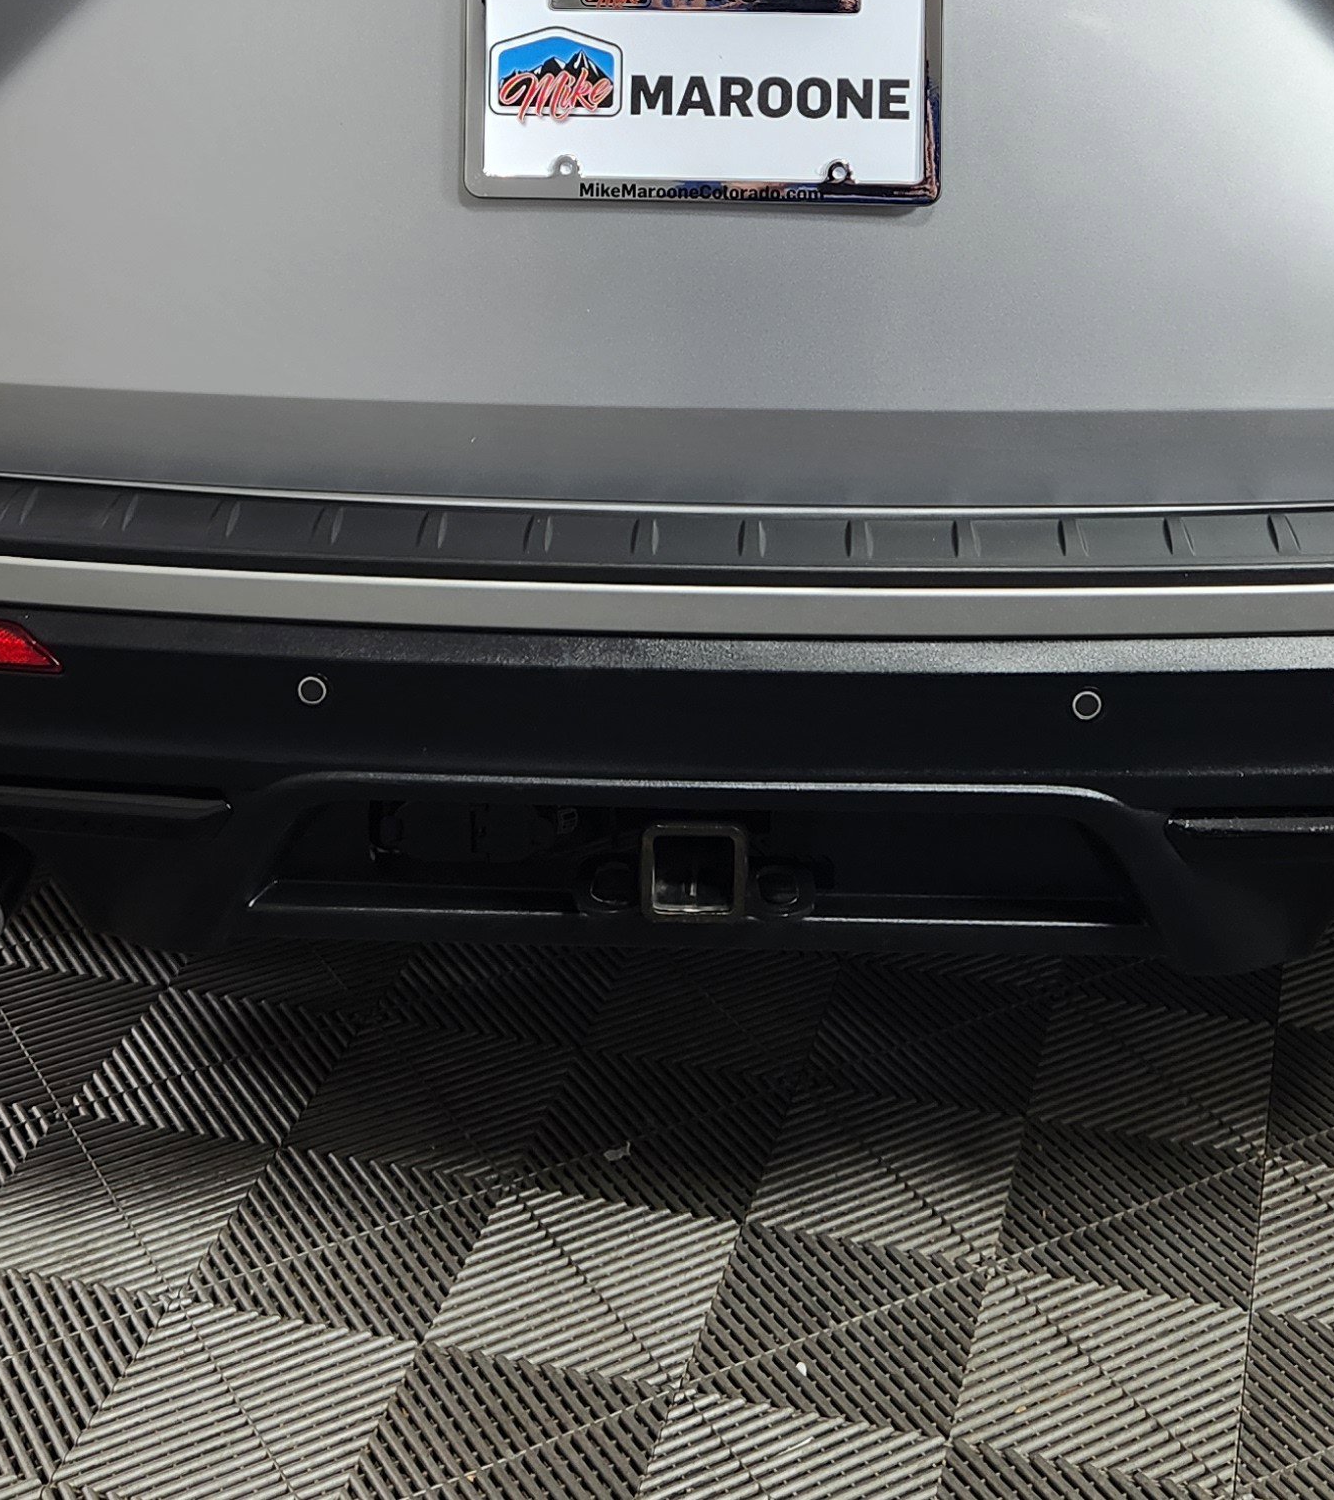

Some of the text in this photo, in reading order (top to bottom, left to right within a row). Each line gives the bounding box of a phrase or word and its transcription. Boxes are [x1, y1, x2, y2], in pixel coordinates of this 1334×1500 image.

[499, 71, 911, 124] Mike MAROONE
[579, 181, 825, 201] MikeMarooneColorado.com
